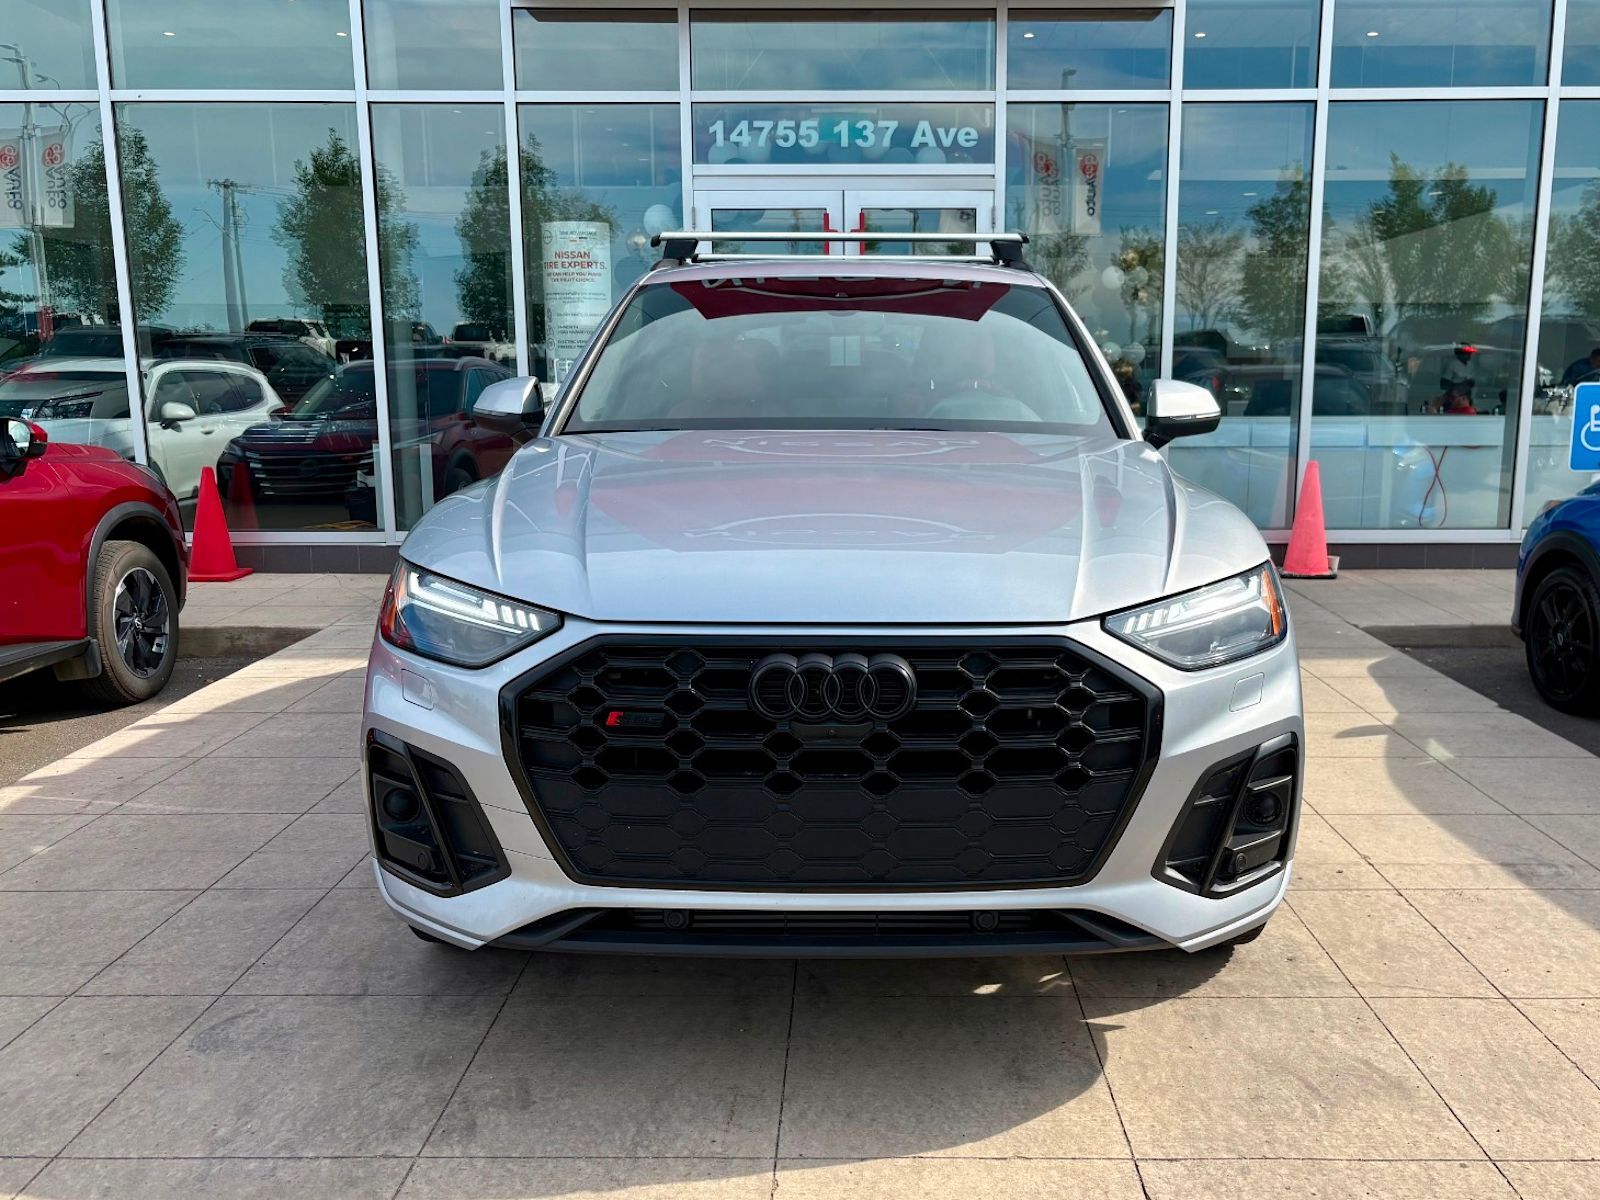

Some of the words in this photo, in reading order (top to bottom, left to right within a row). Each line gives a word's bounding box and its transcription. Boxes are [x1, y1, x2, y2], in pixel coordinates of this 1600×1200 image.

[708, 120, 820, 148] 14755
[833, 120, 899, 148] 137
[910, 120, 979, 148] Ave
[554, 251, 591, 259] NISSAN
[561, 261, 608, 270] EXPERTS.
